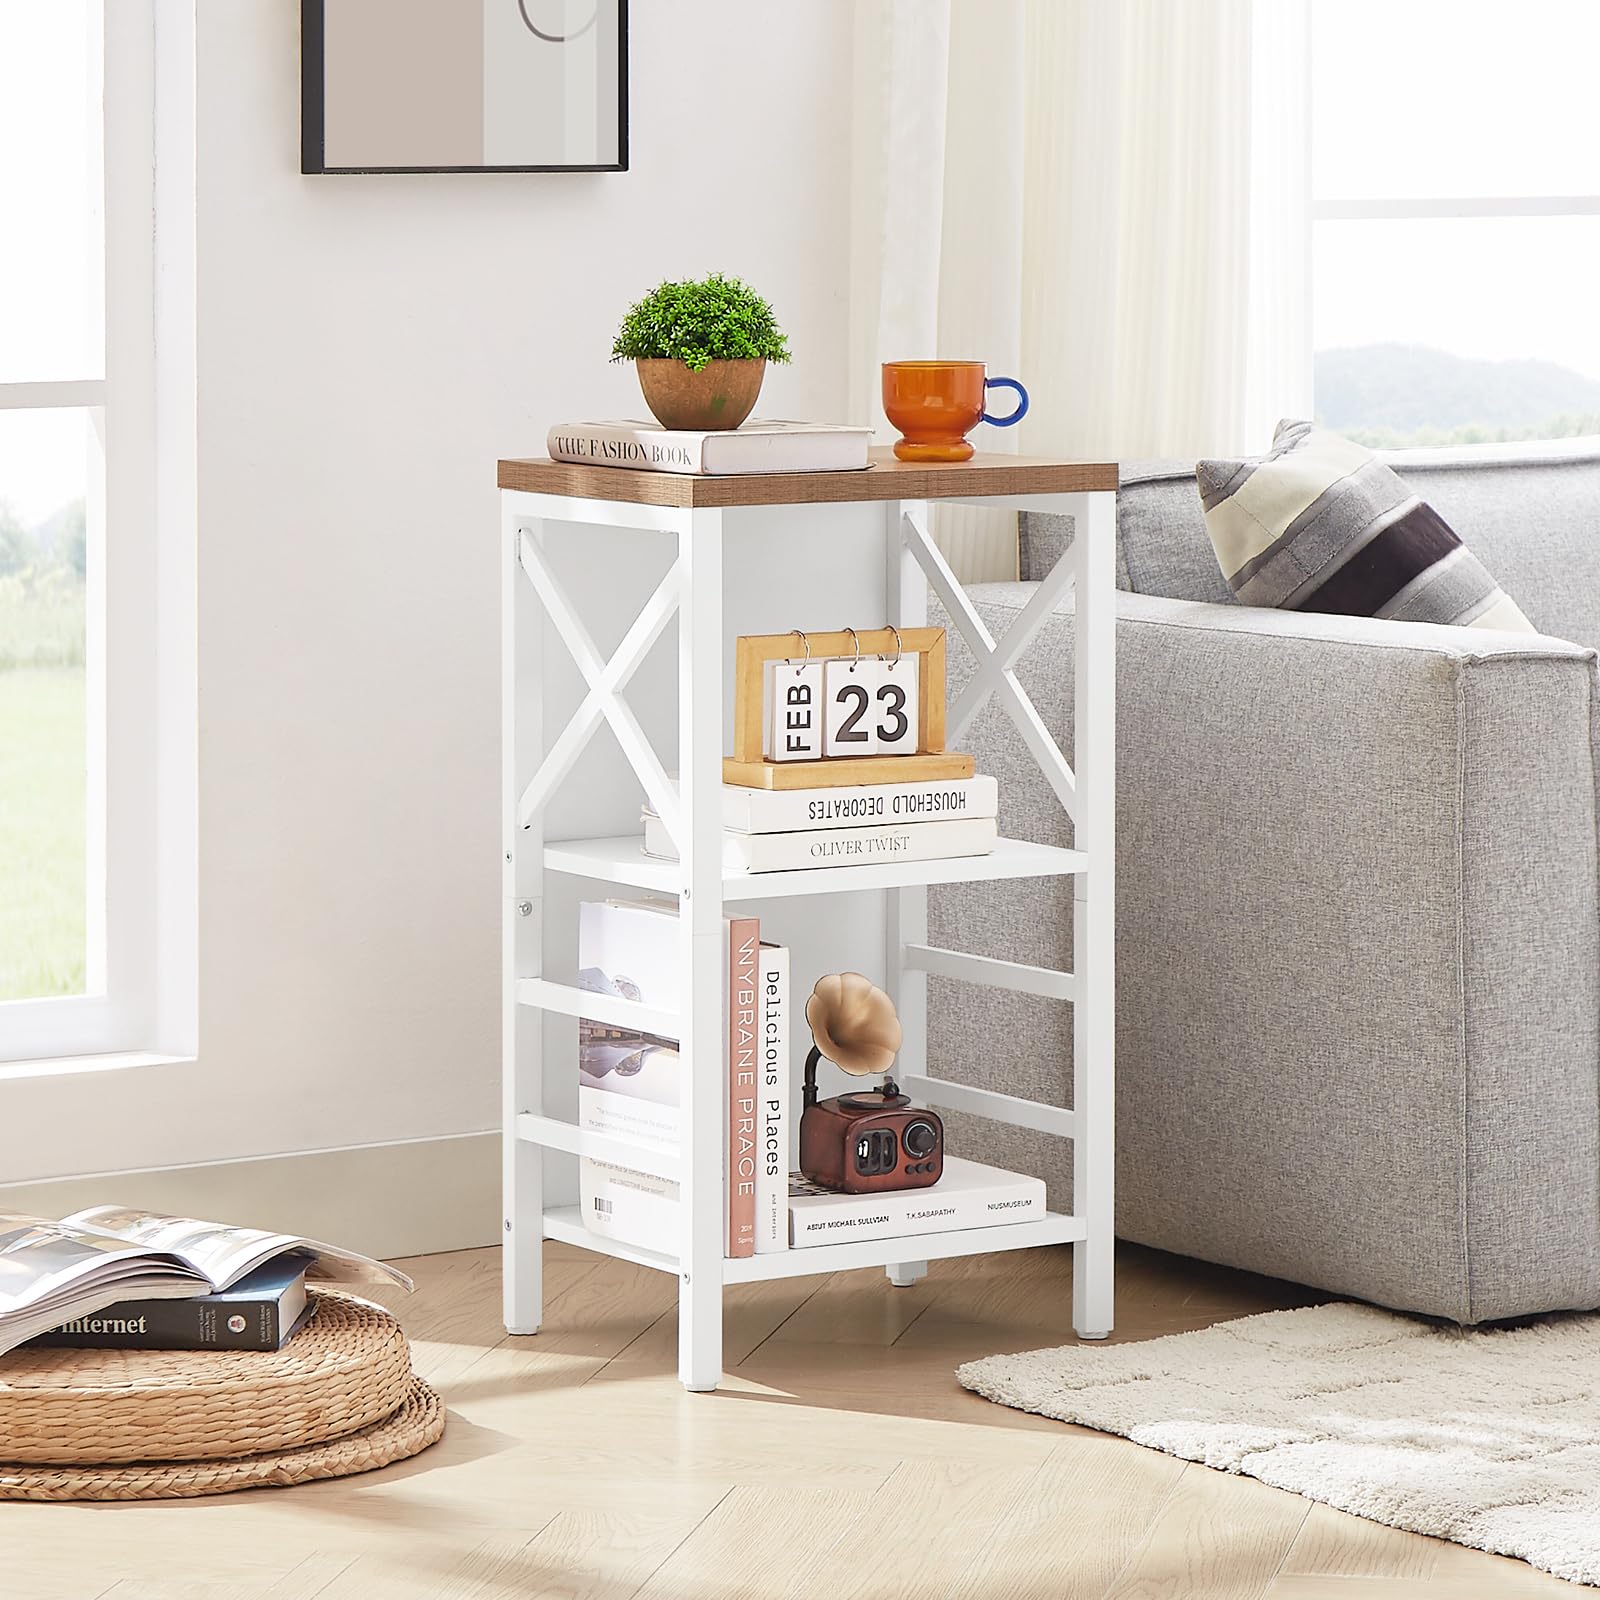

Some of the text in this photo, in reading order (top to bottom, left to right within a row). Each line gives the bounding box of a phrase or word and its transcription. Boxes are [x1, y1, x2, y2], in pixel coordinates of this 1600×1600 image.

[555, 436, 692, 465] THE FASHON BOOK
[786, 684, 812, 752] FEB
[835, 684, 908, 743] 23
[808, 791, 966, 820] HOUSEHOLD DECORATES
[810, 836, 910, 857] OLIVER TWIST
[737, 936, 755, 1196] WYBRANE PRACE
[765, 971, 781, 1176] Delicious Places
[827, 1219, 857, 1229] MICHAEL
